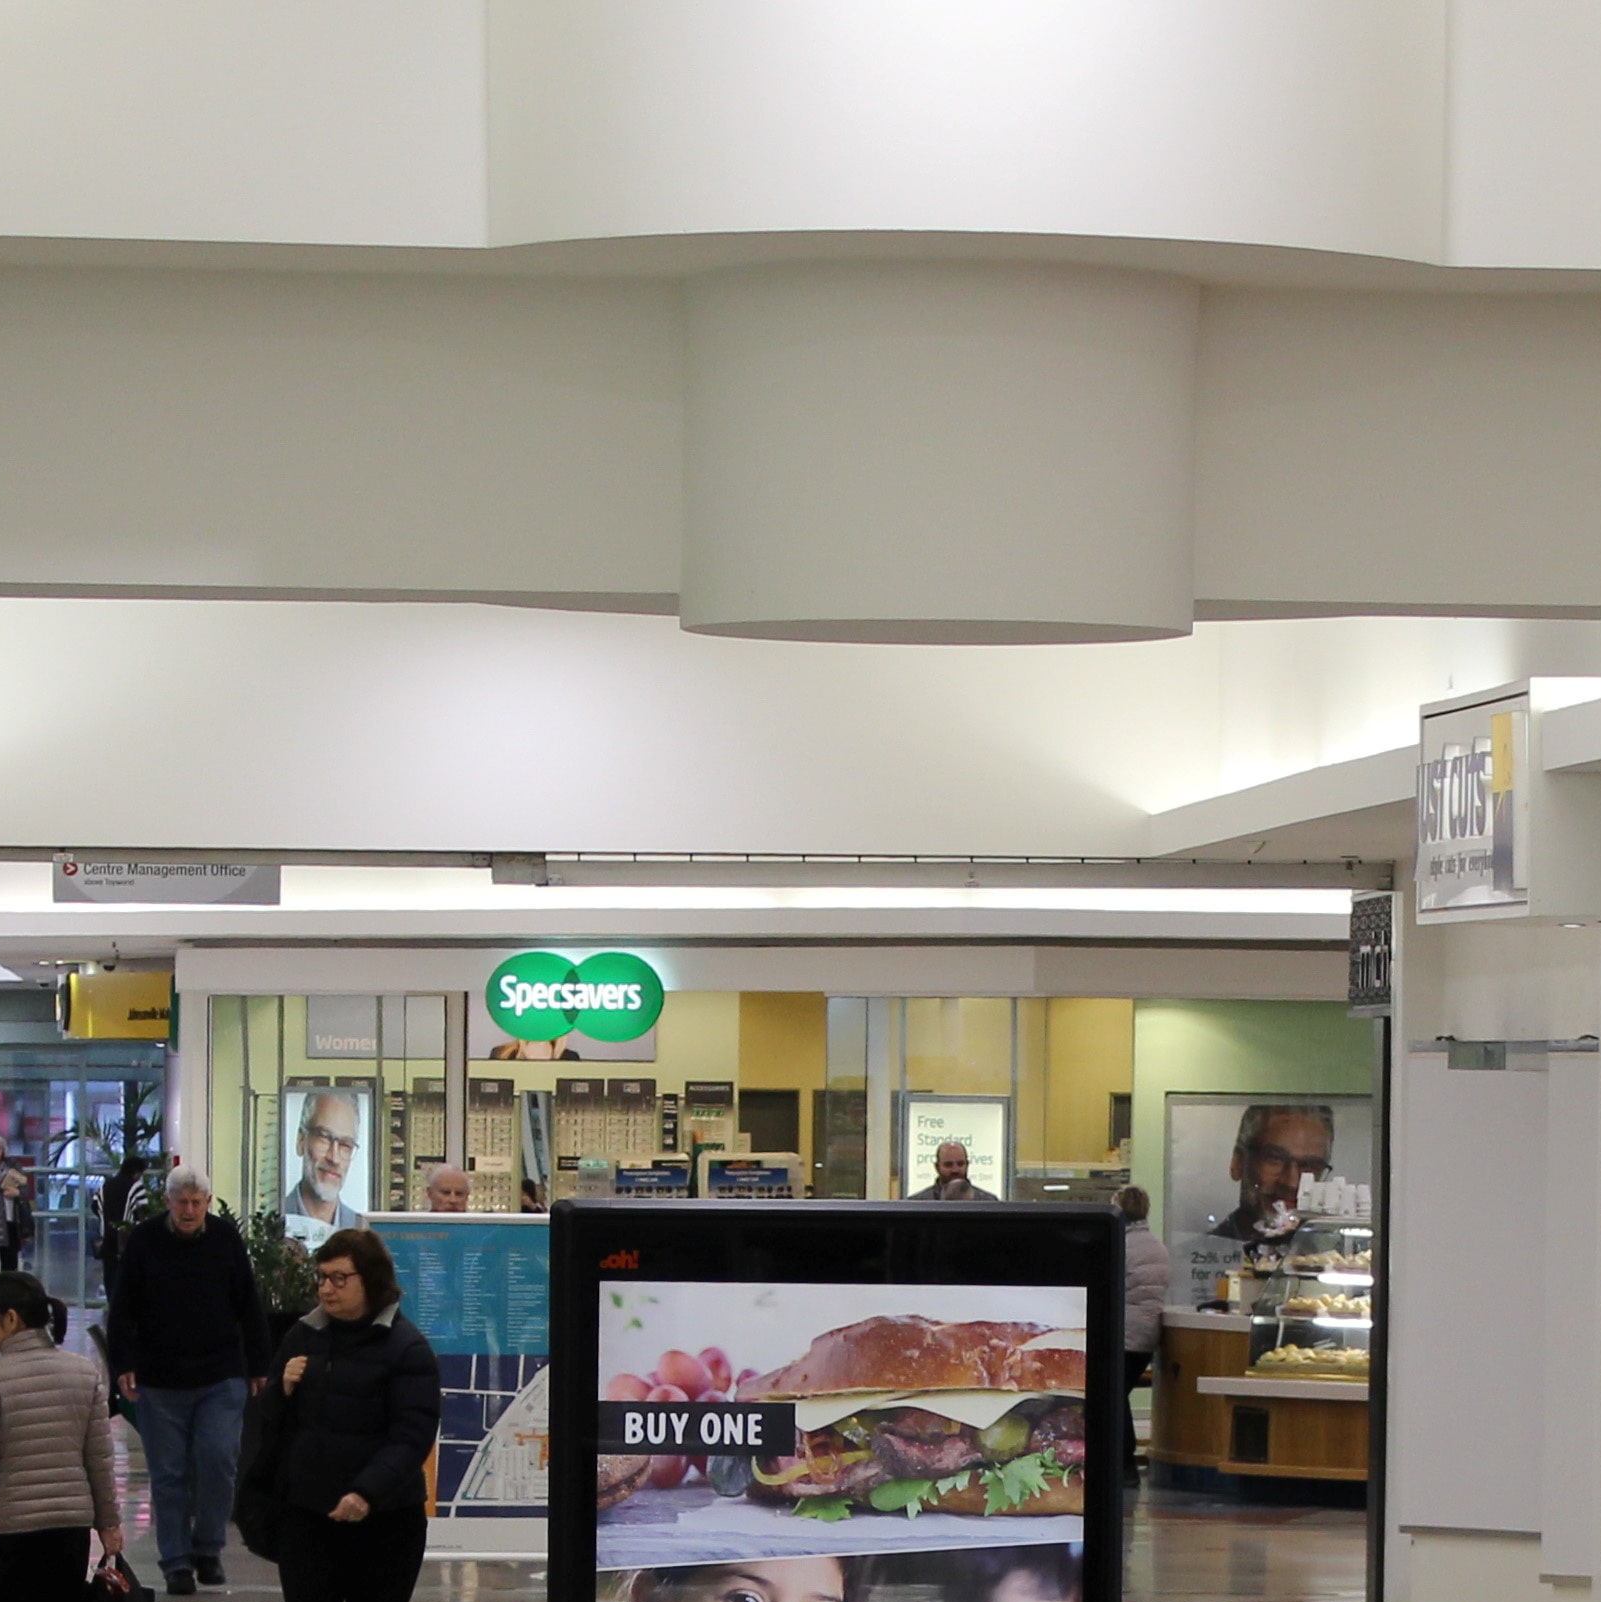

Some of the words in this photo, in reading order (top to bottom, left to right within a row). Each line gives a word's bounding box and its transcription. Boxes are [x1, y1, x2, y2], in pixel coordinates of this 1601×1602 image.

[83, 863, 123, 876] Centre
[127, 863, 207, 878] Management
[211, 864, 246, 877] Office
[500, 974, 643, 1017] Specsavers
[917, 1115, 945, 1128] Free
[917, 1133, 973, 1147] Standard
[624, 1412, 689, 1445] BUY
[700, 1413, 763, 1446] ONE
